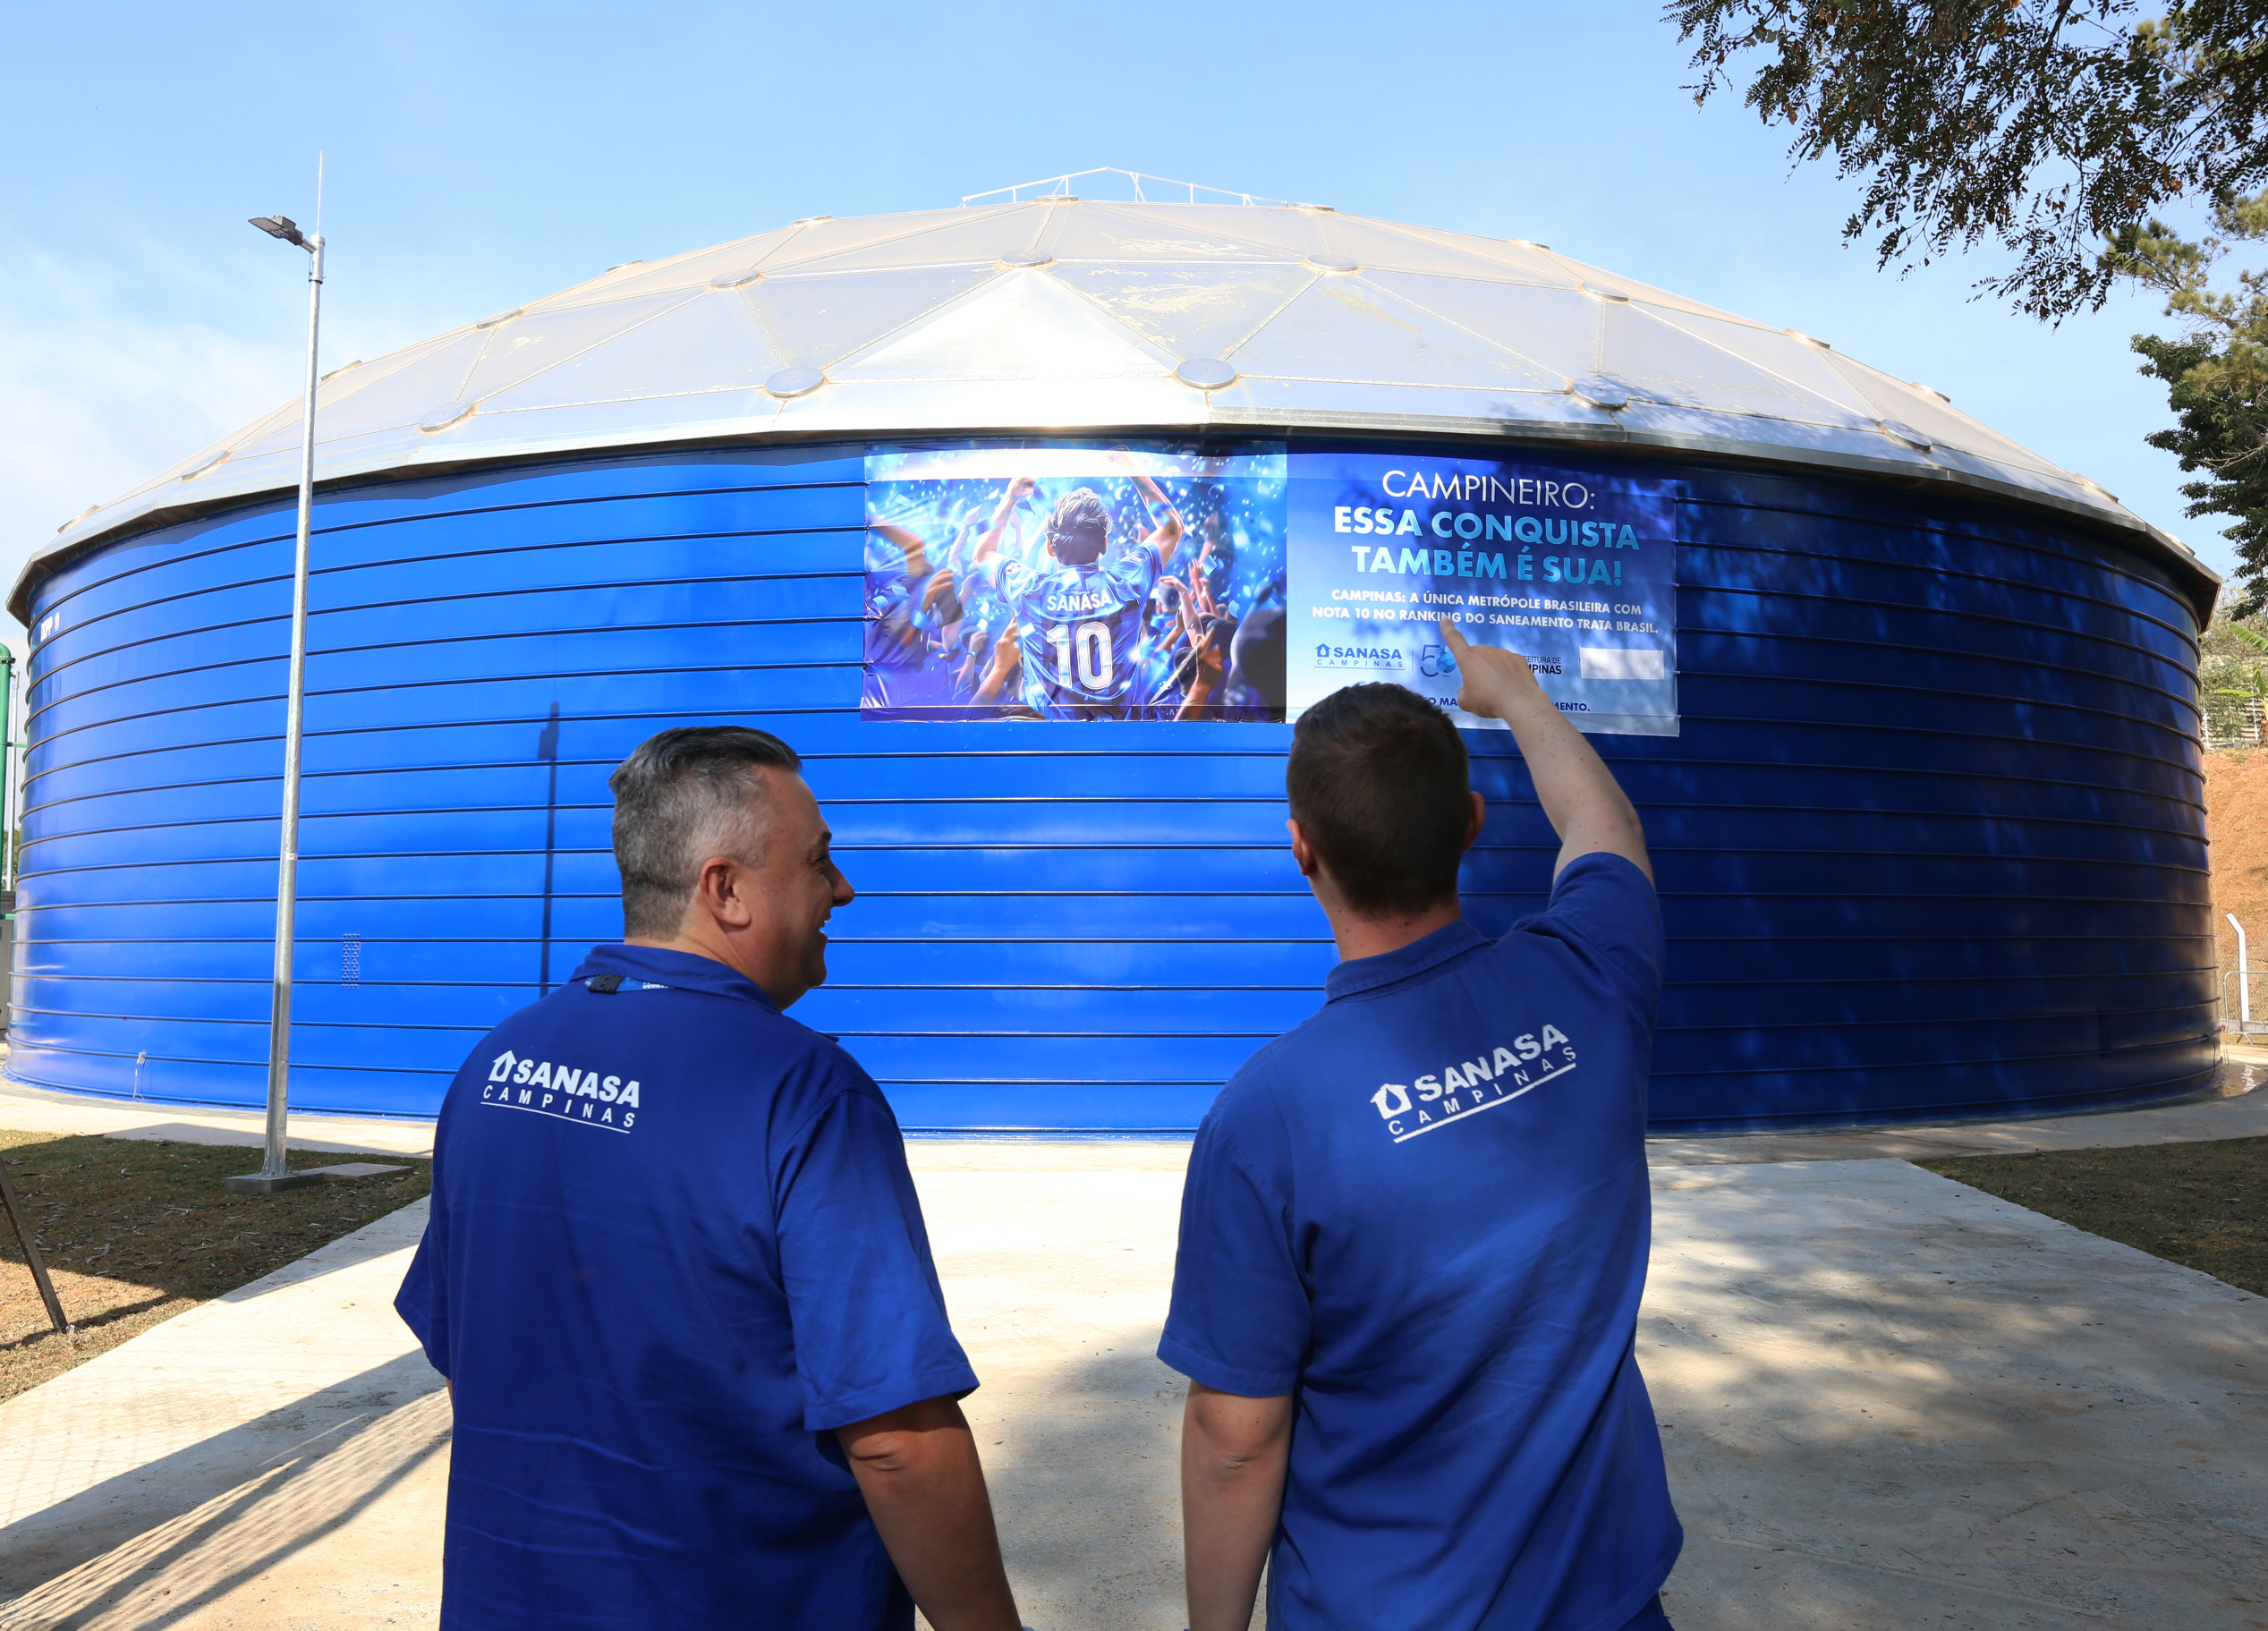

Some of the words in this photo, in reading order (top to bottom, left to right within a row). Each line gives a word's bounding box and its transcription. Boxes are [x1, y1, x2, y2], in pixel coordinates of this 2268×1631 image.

[1382, 470, 1595, 510] CAMPINEIRO:
[1334, 505, 1423, 537] ESSA
[1431, 511, 1640, 551] CONQUISTA
[1351, 541, 1511, 580] TAMBÉM
[1519, 546, 1533, 581] É
[1542, 557, 1622, 587] SUA!
[1046, 590, 1113, 612] SANASA
[1312, 607, 1351, 619] NOTA
[1355, 607, 1371, 619] 10
[1373, 608, 1396, 620] NO
[1399, 610, 1462, 624] RANKING
[1465, 613, 1485, 624] DO
[1489, 614, 1575, 629] SANEAMENTO
[1576, 618, 1613, 631] TRATA
[1616, 621, 1659, 633] BRASIL.
[1331, 589, 1406, 603] CAMPINAS:
[1409, 592, 1420, 603] A
[1423, 590, 1465, 606] ÚNICA
[1467, 594, 1541, 609] METRÓPOLE
[1543, 599, 1611, 614] BRASILEIRA
[1613, 604, 1642, 616] COM
[1046, 621, 1114, 690] 10
[1317, 658, 1403, 667] CAMPINAS
[1333, 647, 1403, 659] SANASA
[513, 1059, 640, 1109] SANASA
[1414, 1024, 1569, 1102] SANASA
[483, 1084, 636, 1128] CAMPINAS
[1389, 1047, 1576, 1135] CAMPINAS
